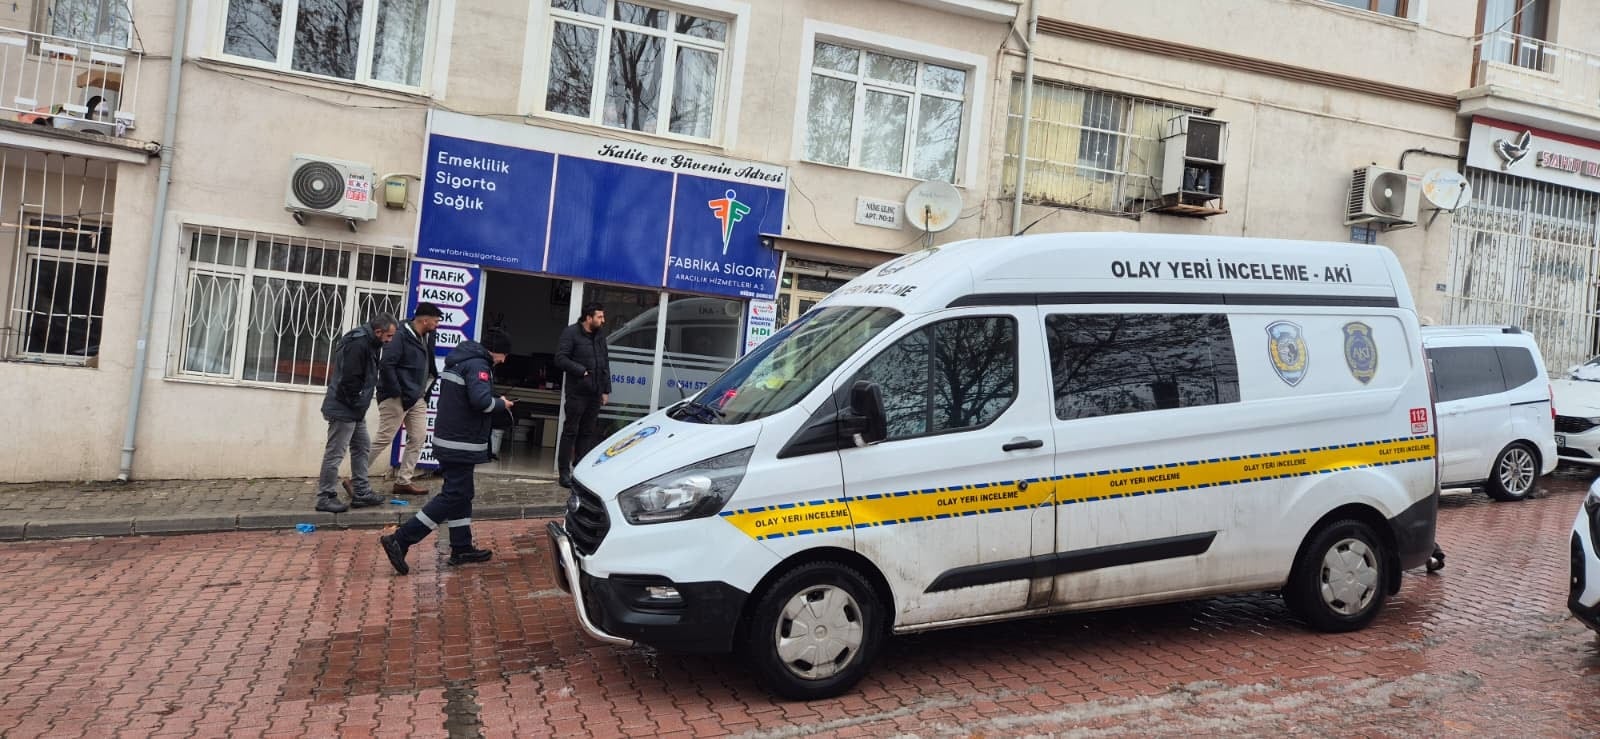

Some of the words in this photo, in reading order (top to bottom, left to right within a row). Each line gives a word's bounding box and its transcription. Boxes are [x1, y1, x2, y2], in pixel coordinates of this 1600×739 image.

[438, 151, 510, 174] Emeklilik
[598, 144, 648, 162] Kalite
[652, 156, 667, 165] ve
[670, 154, 731, 175] Güvenin
[734, 166, 784, 183] Adresi
[435, 171, 496, 191] Sigorta
[433, 192, 484, 210] Sağlık
[428, 247, 519, 263] www.fabrikasigorta.com
[668, 256, 720, 273] FABRİKA
[723, 262, 777, 280] SİGORTA
[1111, 260, 1161, 278] OLAY
[1168, 258, 1213, 279] YERİ
[1218, 258, 1309, 281] İNCELEME
[1324, 263, 1353, 283] AKİ
[422, 288, 464, 303] KASKO
[751, 327, 770, 337] HDI
[1411, 410, 1426, 421] 112
[1110, 479, 1128, 487] OLAY
[937, 497, 958, 506] OLAY
[755, 518, 778, 528] OLAY
